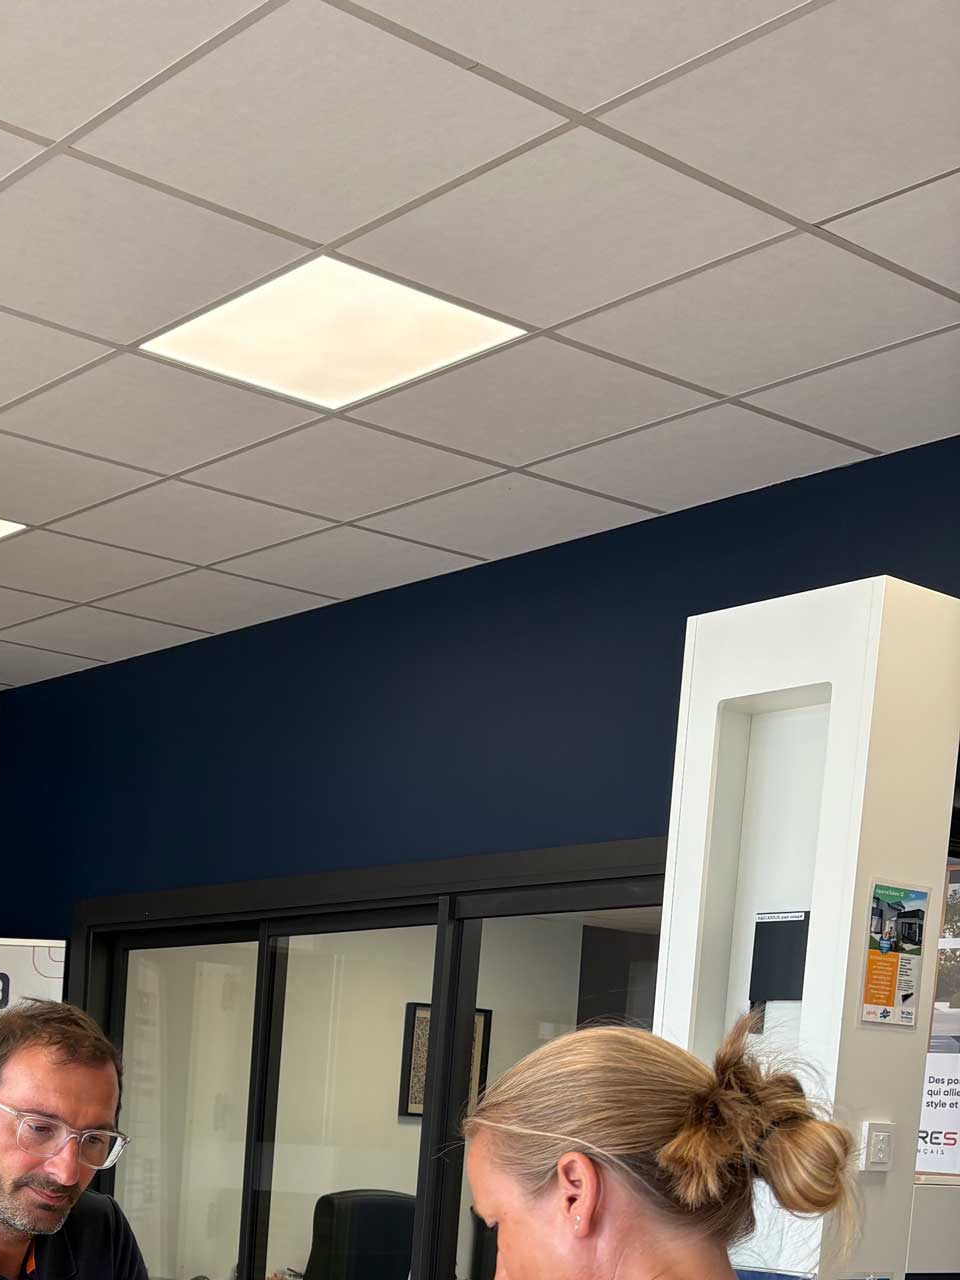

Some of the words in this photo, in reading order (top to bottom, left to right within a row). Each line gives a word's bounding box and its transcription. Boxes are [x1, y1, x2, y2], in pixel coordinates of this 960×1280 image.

[928, 1075, 945, 1084] Des
[927, 1087, 942, 1097] qui
[926, 1099, 947, 1110] style
[948, 1101, 959, 1109] et
